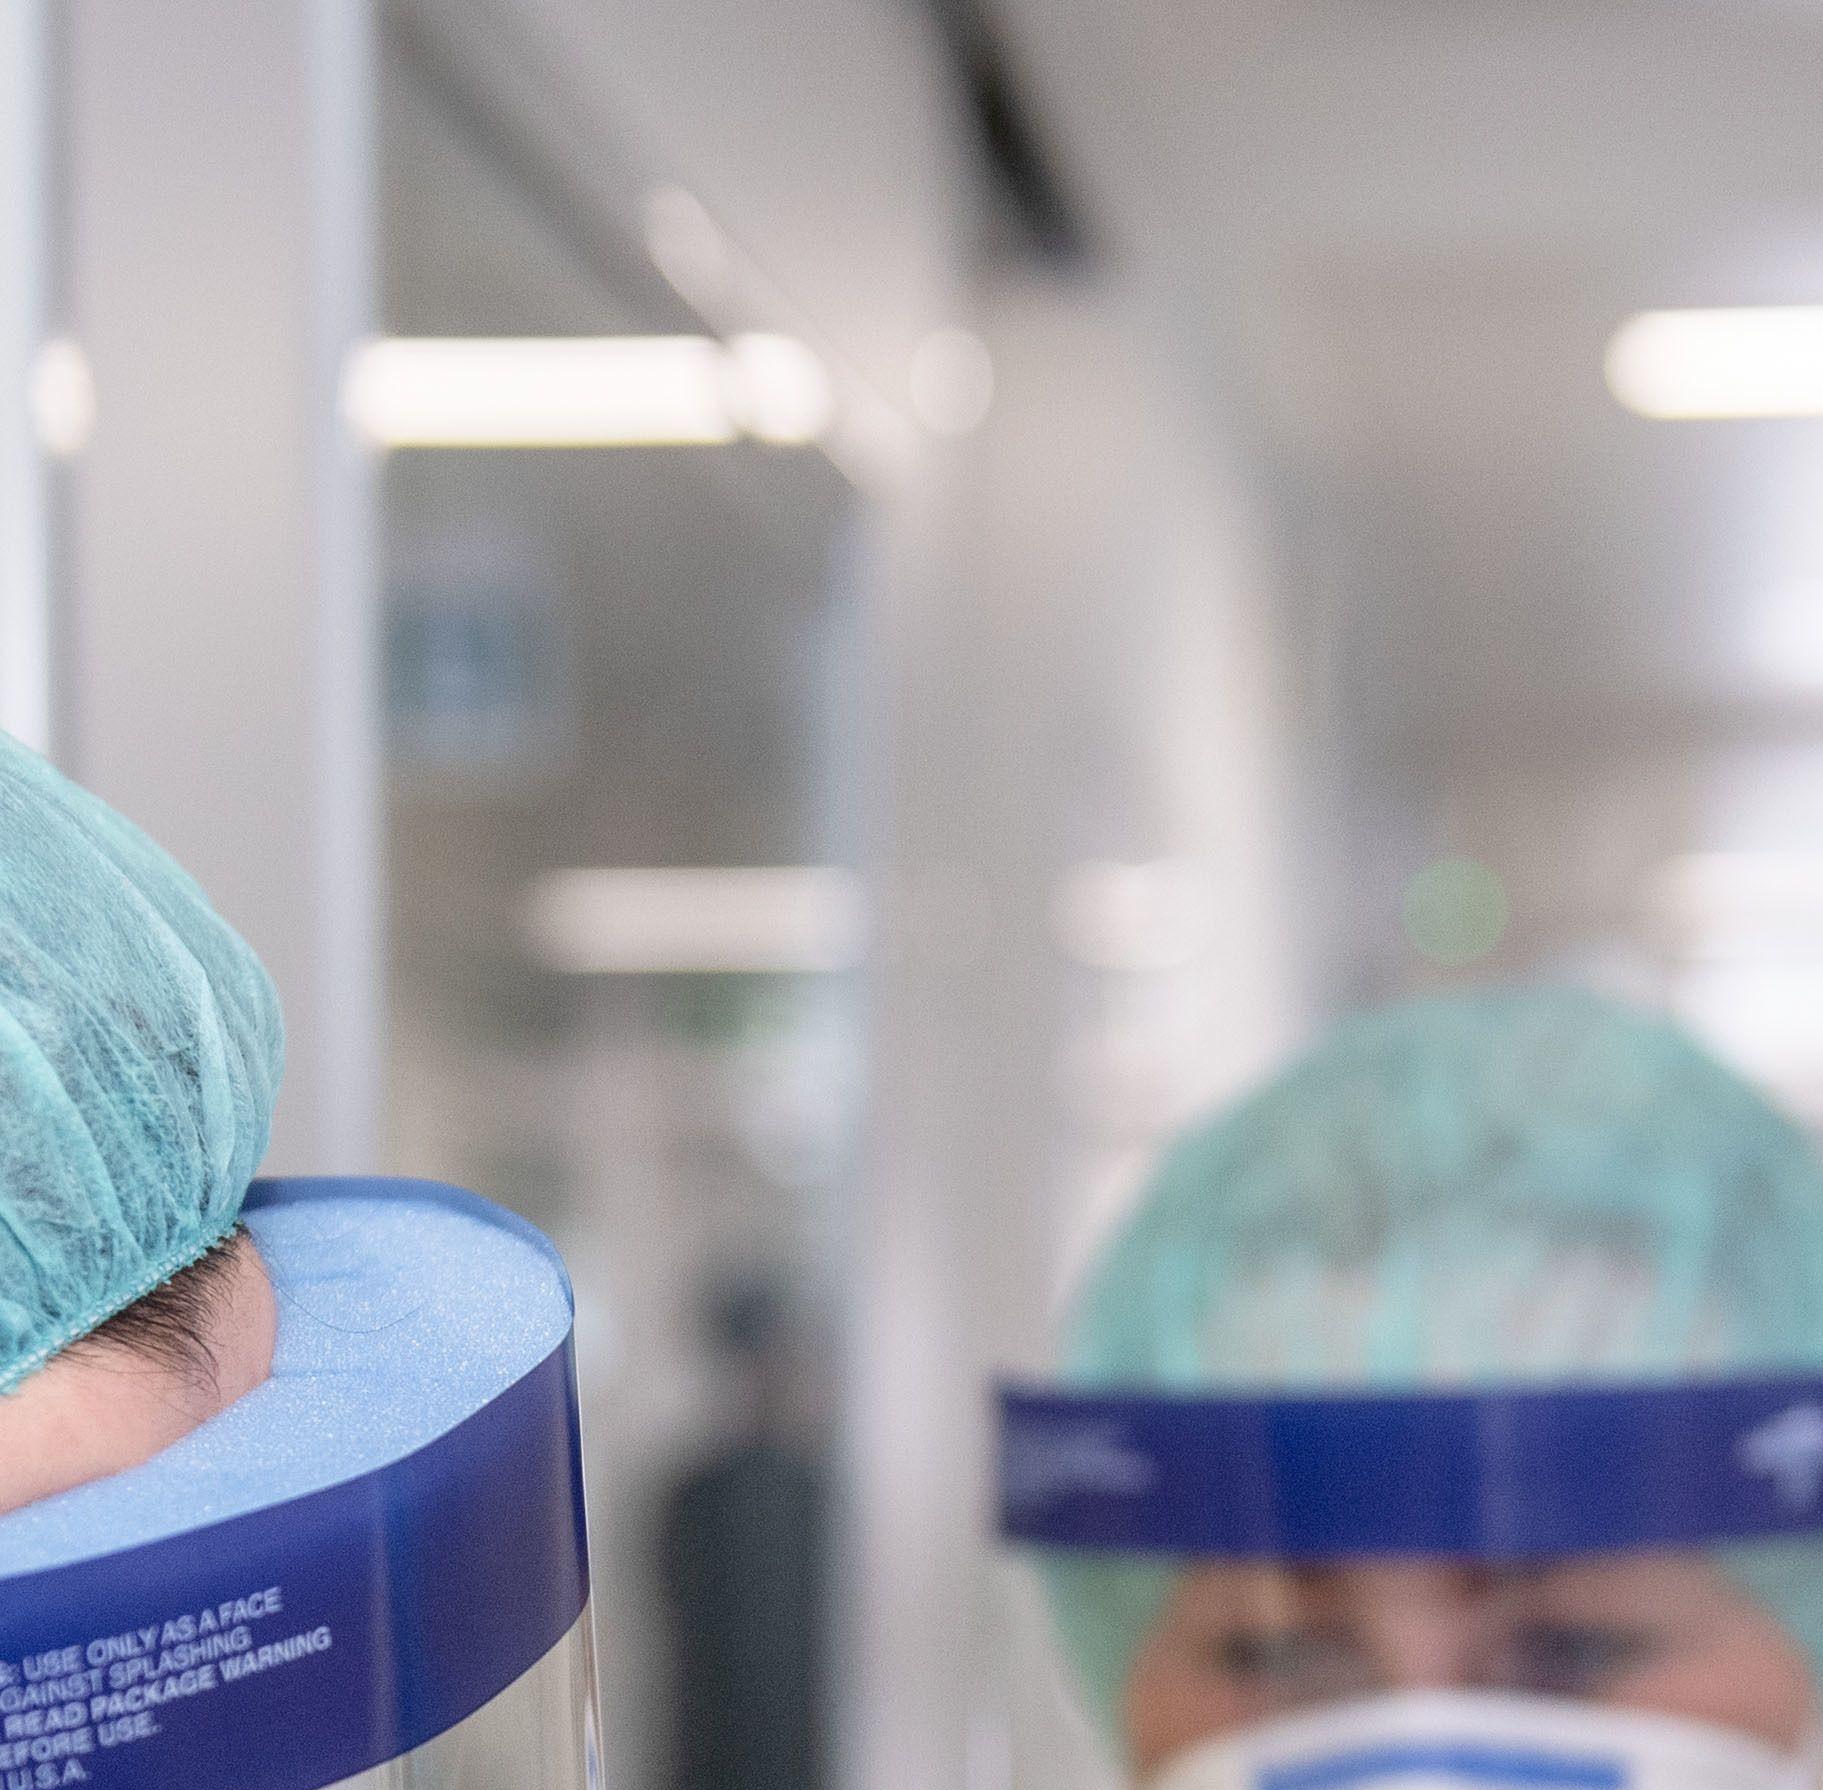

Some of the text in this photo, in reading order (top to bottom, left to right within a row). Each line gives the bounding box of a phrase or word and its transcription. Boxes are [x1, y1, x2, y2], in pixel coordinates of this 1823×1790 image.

[22, 1645, 83, 1681] USE
[86, 1625, 159, 1667] ONLY
[161, 1614, 198, 1646] AS
[199, 1608, 219, 1635] A
[218, 1586, 284, 1627] FACE
[109, 1625, 253, 1689] SPLASHING
[4, 1701, 88, 1739] READ
[90, 1664, 219, 1722] PACKAGE
[219, 1626, 333, 1682] WARNING
[98, 1710, 162, 1746] USE.
